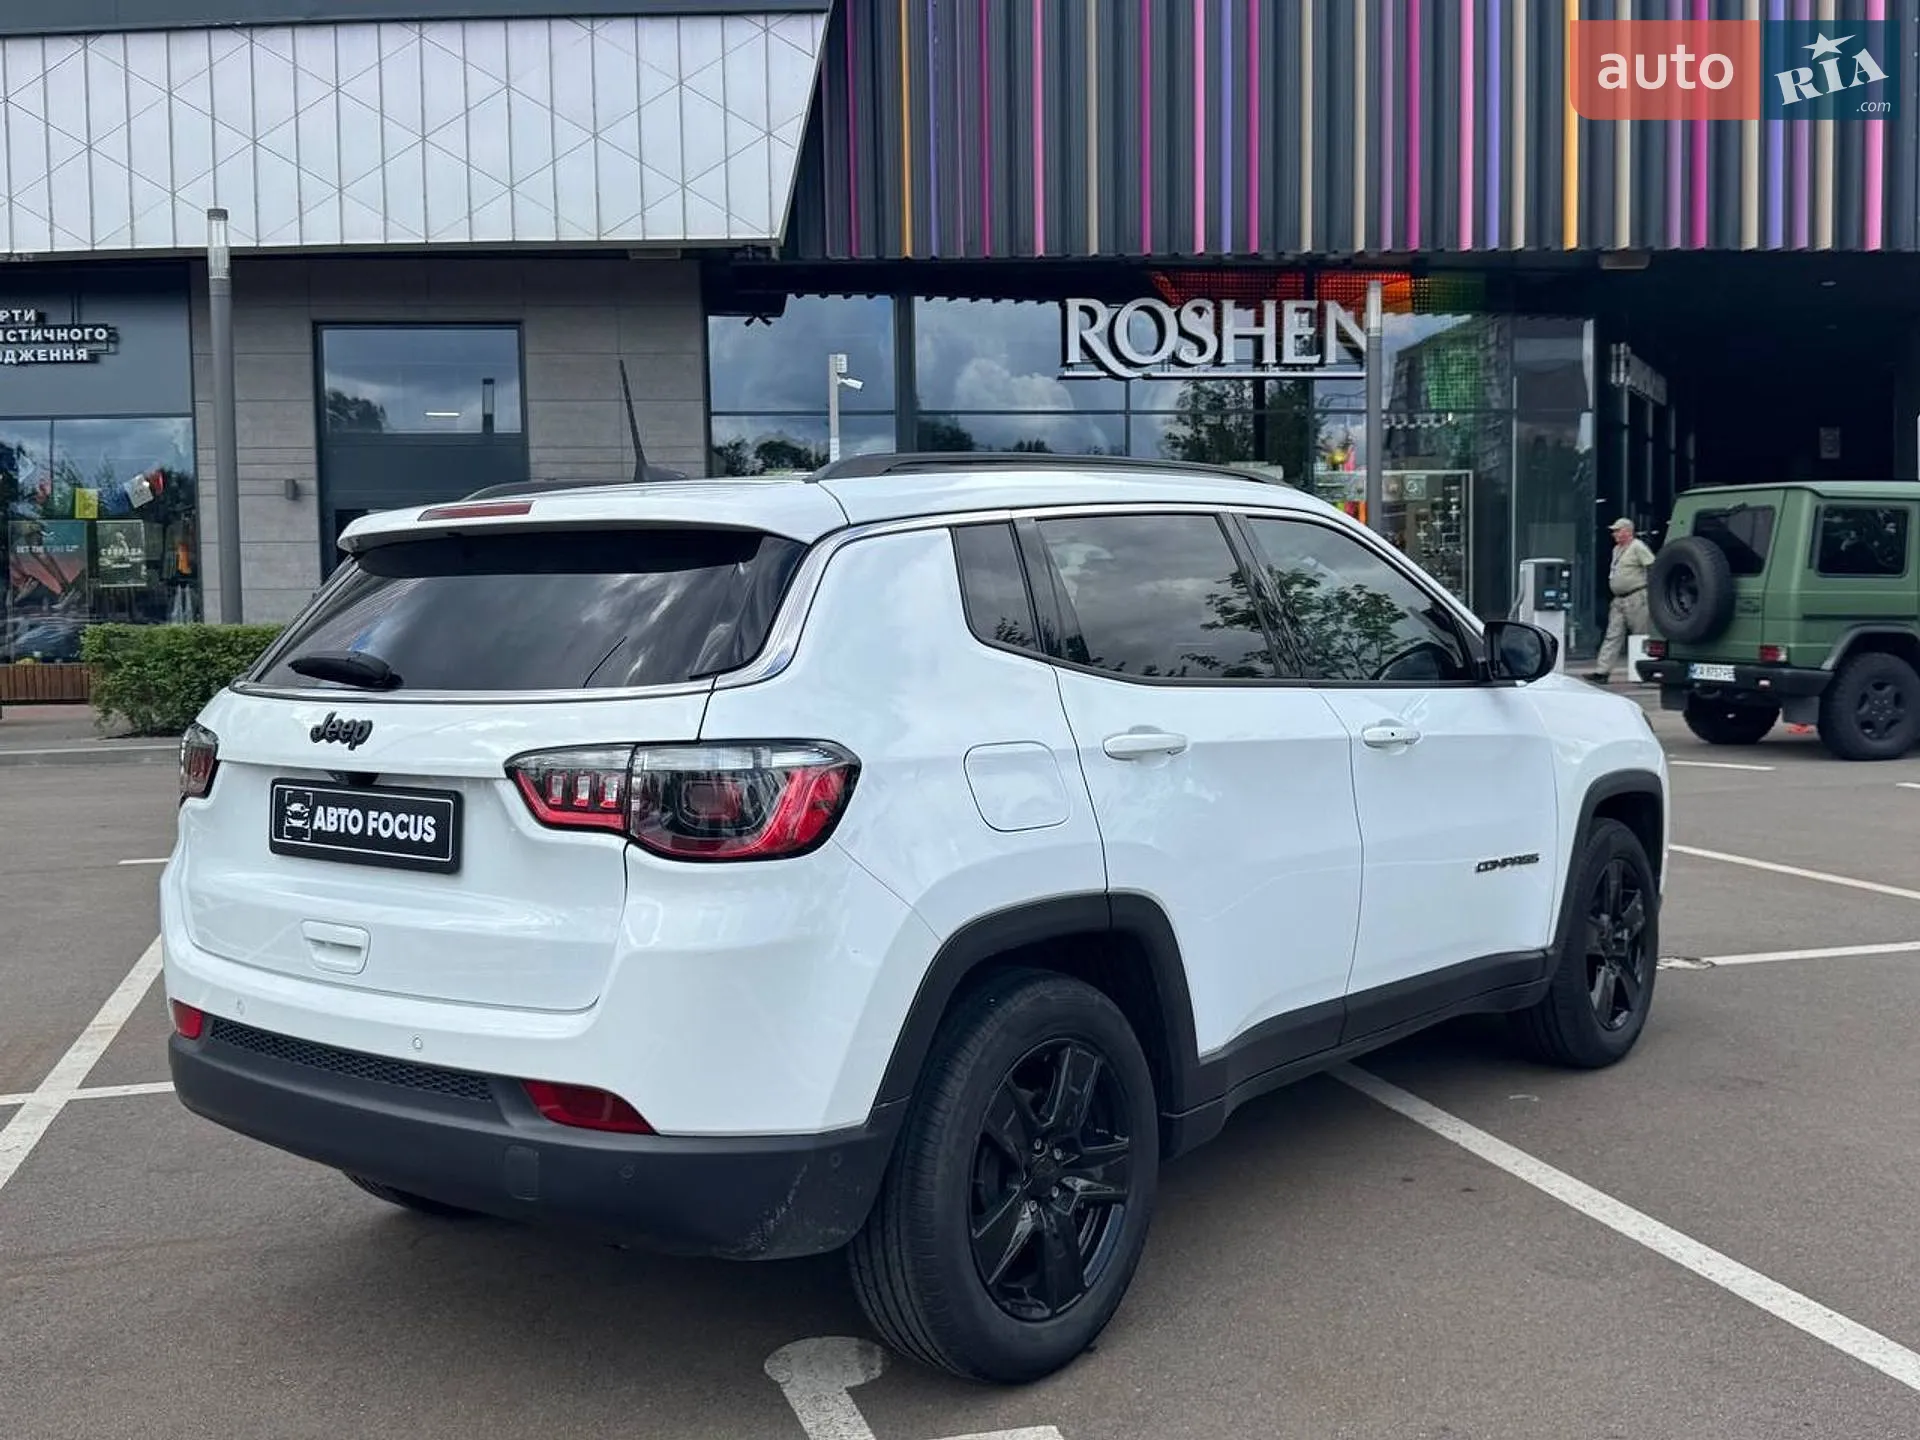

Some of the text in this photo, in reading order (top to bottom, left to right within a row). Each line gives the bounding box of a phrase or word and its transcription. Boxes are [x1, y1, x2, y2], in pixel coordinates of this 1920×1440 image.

[0, 348, 88, 364] ДЖЕННЯ
[1064, 297, 1367, 378] ROSHEN
[310, 711, 374, 751] Jeep
[367, 810, 437, 844] FOCUS
